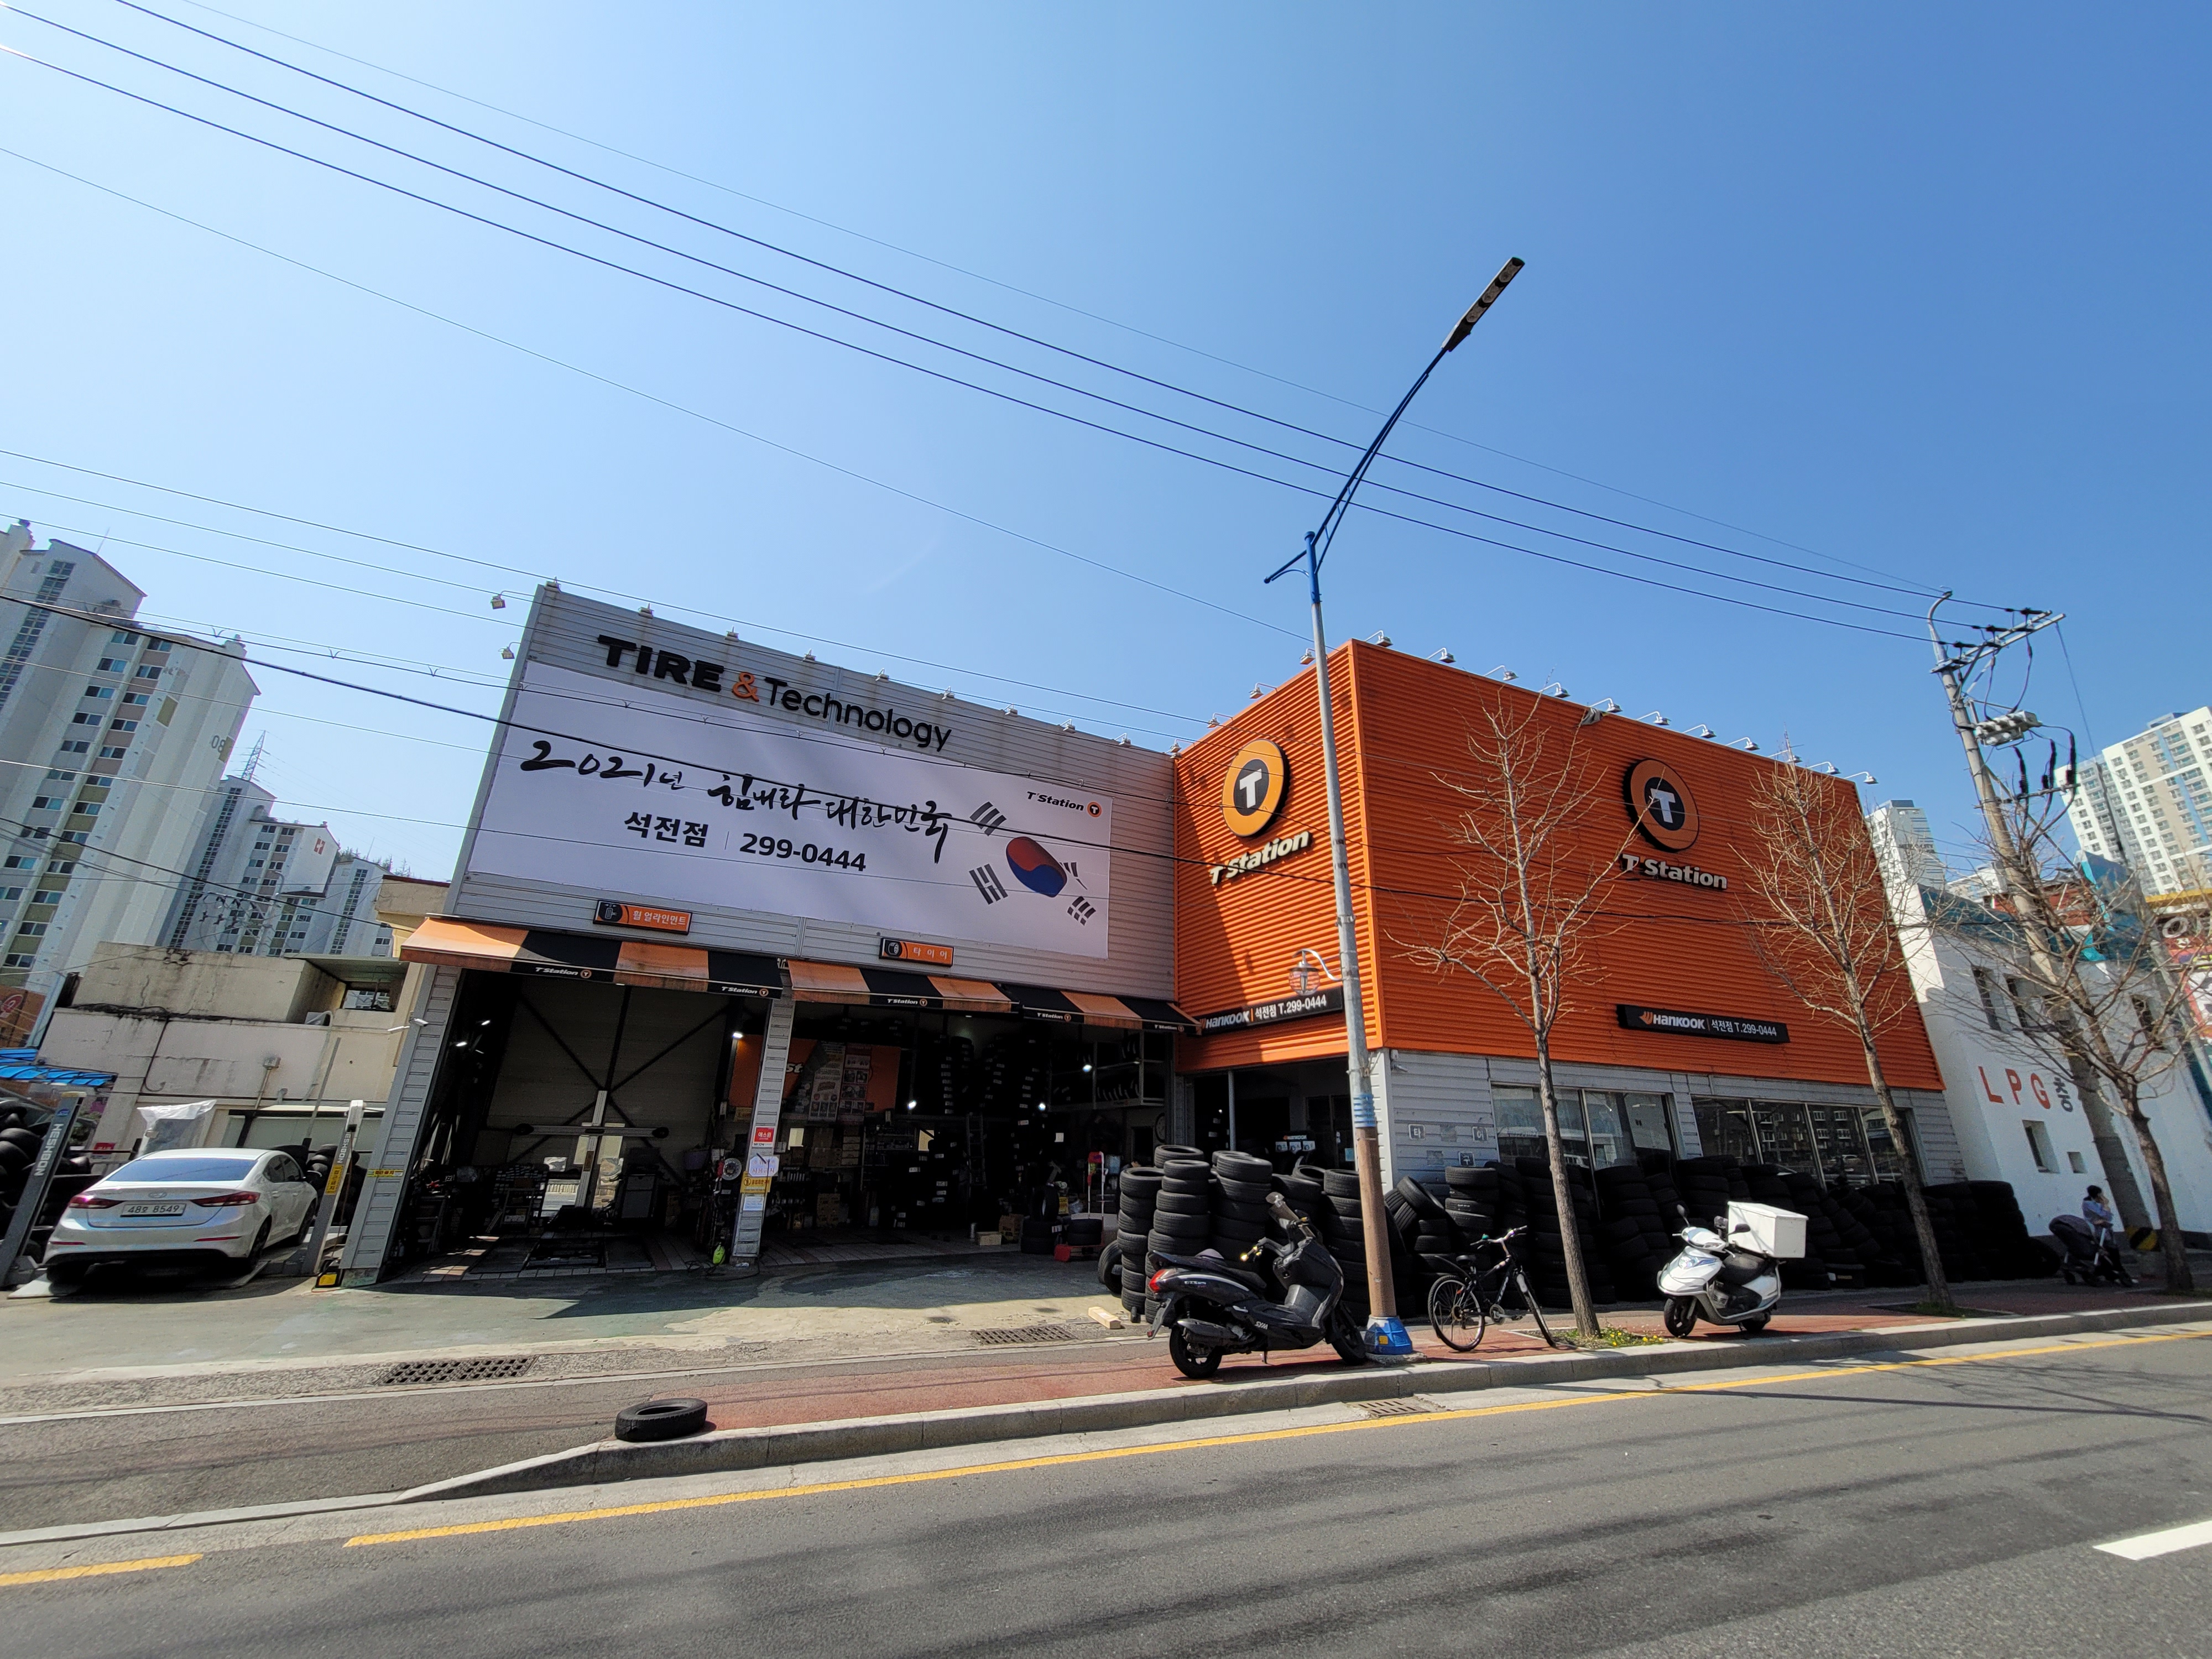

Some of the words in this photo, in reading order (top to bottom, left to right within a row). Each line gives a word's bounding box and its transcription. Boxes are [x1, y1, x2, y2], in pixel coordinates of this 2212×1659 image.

[598, 634, 724, 692] TIRE
[764, 676, 952, 752] Technology
[624, 811, 709, 848] 석전점
[739, 833, 867, 872] 299-0444
[1255, 1006, 1277, 1020] 석전점
[1711, 1019, 1734, 1033] 석전점
[1978, 1066, 2051, 1109] LPG
[337, 1132, 351, 1164] ESHBON
[1254, 1321, 1269, 1330] SYM
